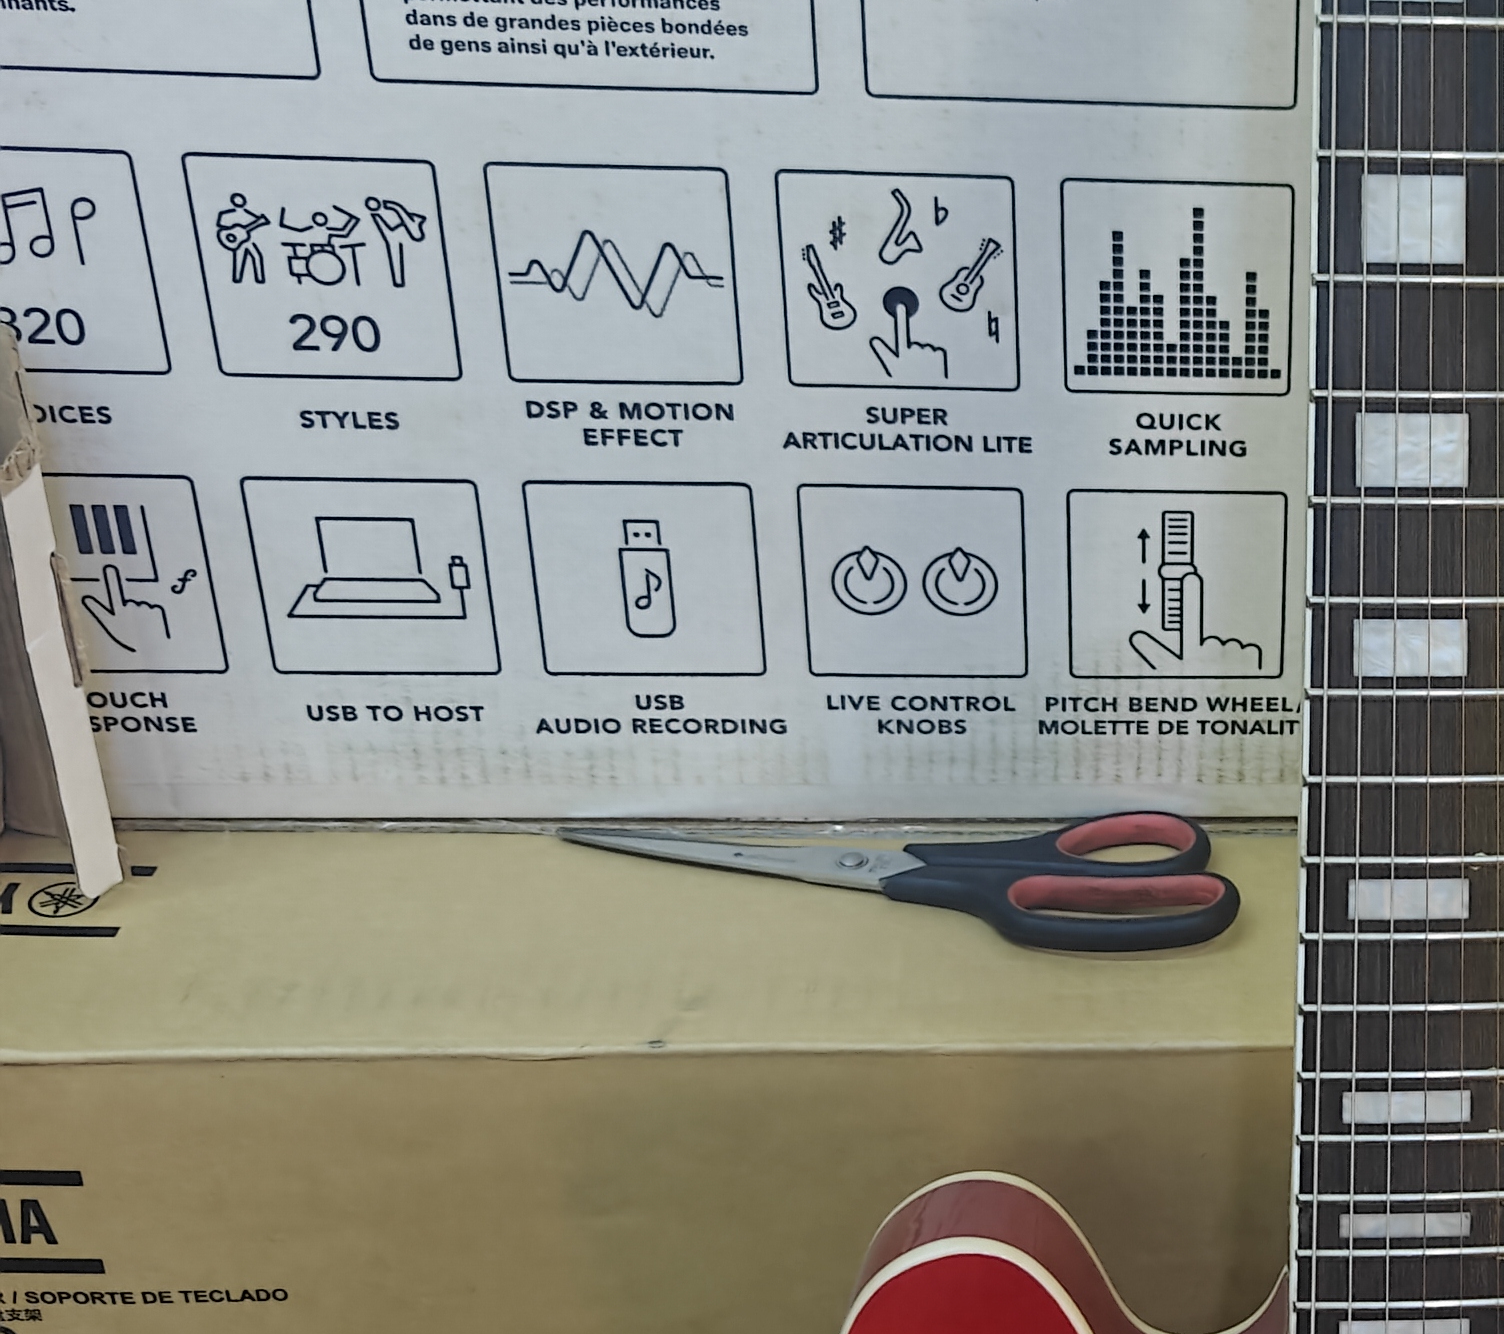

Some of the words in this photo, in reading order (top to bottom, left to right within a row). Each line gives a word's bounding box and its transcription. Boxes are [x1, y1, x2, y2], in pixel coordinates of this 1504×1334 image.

[289, 314, 381, 353] 290
[525, 401, 578, 419] DSP
[590, 401, 608, 419] &
[619, 402, 734, 421] MOTION
[866, 406, 948, 426] SUPER
[299, 410, 400, 430] STYLES
[1136, 413, 1221, 431] QUICK
[583, 428, 683, 447] EFFECT
[782, 432, 973, 452] ARTICULATION
[983, 435, 1033, 454] LITE
[1109, 438, 1247, 457] SAMPLING
[86, 692, 168, 708] OUCH
[635, 694, 684, 710] USB
[826, 695, 881, 711] LIVE
[891, 696, 1016, 712] CONTROL
[1045, 697, 1117, 712] PITCH
[1129, 697, 1197, 712] BEND
[306, 704, 358, 722] USB
[366, 705, 403, 722] TO
[413, 705, 484, 722] HOST
[89, 716, 197, 732] SPONSE
[536, 718, 621, 734] AUDIO
[632, 718, 787, 735] RECORDING
[878, 719, 967, 734] KNOBS
[1038, 720, 1149, 735] MOLETTE
[1158, 720, 1189, 735] DE
[1197, 720, 1300, 735] TONALIT
[25, 1291, 136, 1305] SOPORTE
[141, 1291, 174, 1304] DE
[178, 1289, 288, 1303] TECLADO
